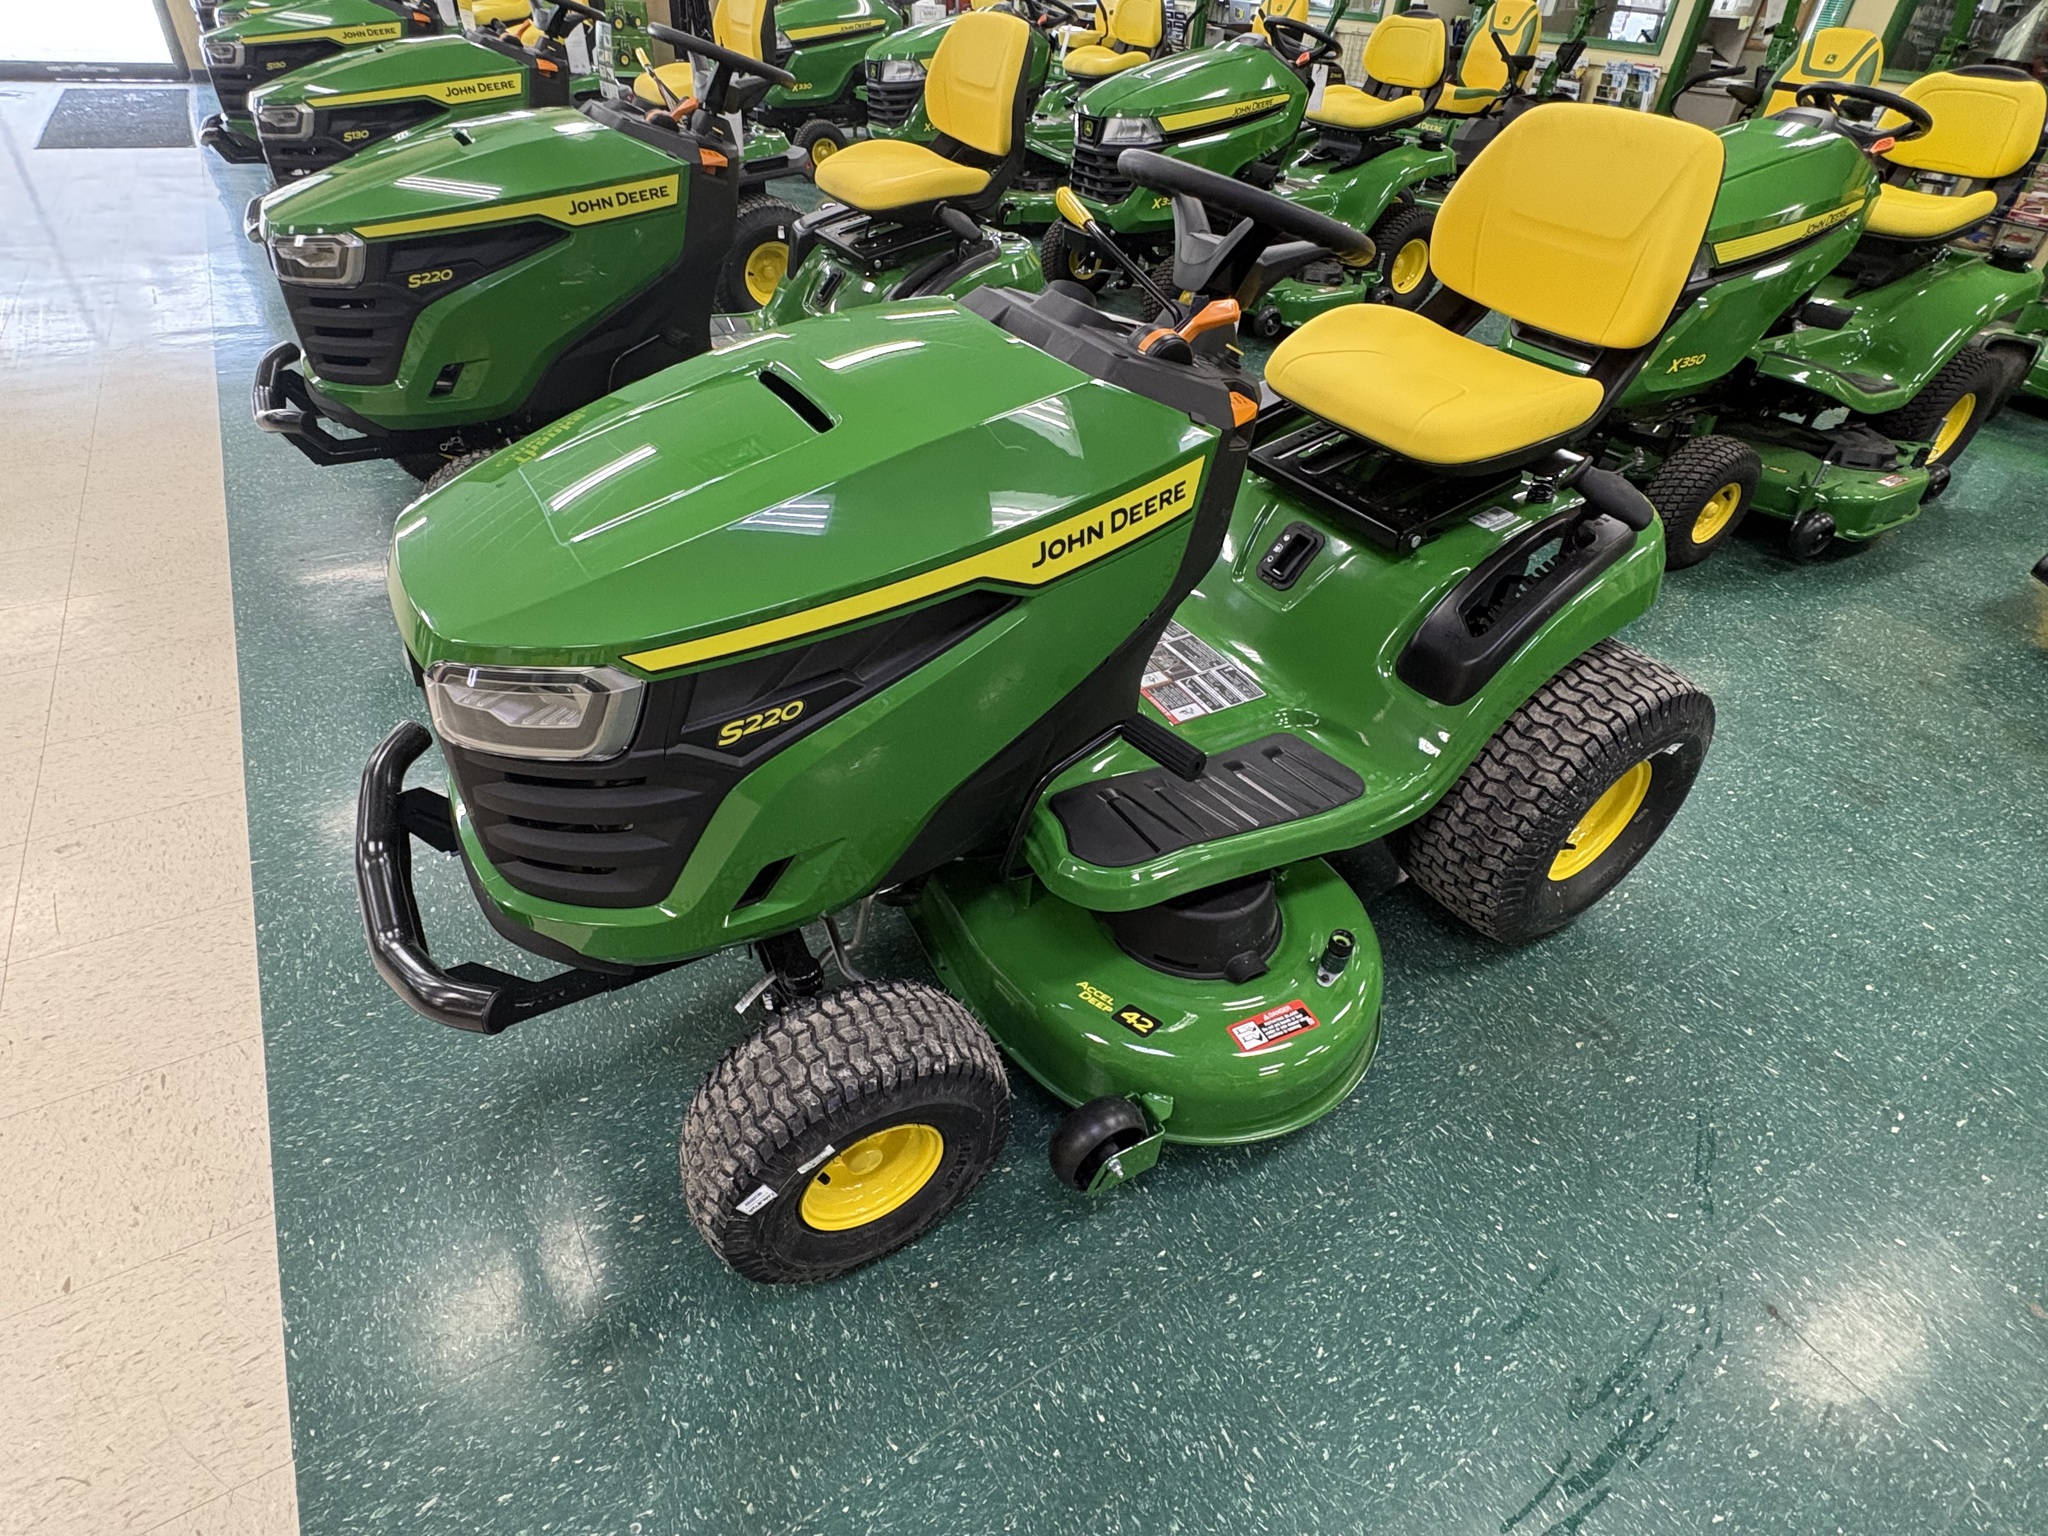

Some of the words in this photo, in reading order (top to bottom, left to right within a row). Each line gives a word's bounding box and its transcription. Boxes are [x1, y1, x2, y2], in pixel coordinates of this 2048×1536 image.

[342, 30, 366, 39] JOHN
[366, 27, 397, 36] DEERE
[445, 86, 476, 97] JOHN
[478, 80, 515, 92] DEERE
[1231, 106, 1252, 118] JOHN
[1252, 98, 1274, 110] DEERE
[343, 130, 370, 142] S130
[568, 200, 613, 216] JOHN
[615, 185, 670, 206] DEERE
[1801, 218, 1827, 237] JOHN
[408, 268, 453, 289] S220
[1665, 353, 1707, 375] X350
[1031, 519, 1105, 569] JOHN
[1110, 479, 1188, 534] DEERE
[717, 699, 805, 747] S220
[1075, 981, 1115, 1006] ACCEL
[1078, 990, 1114, 1013] DEEP
[1120, 1011, 1155, 1034] 42
